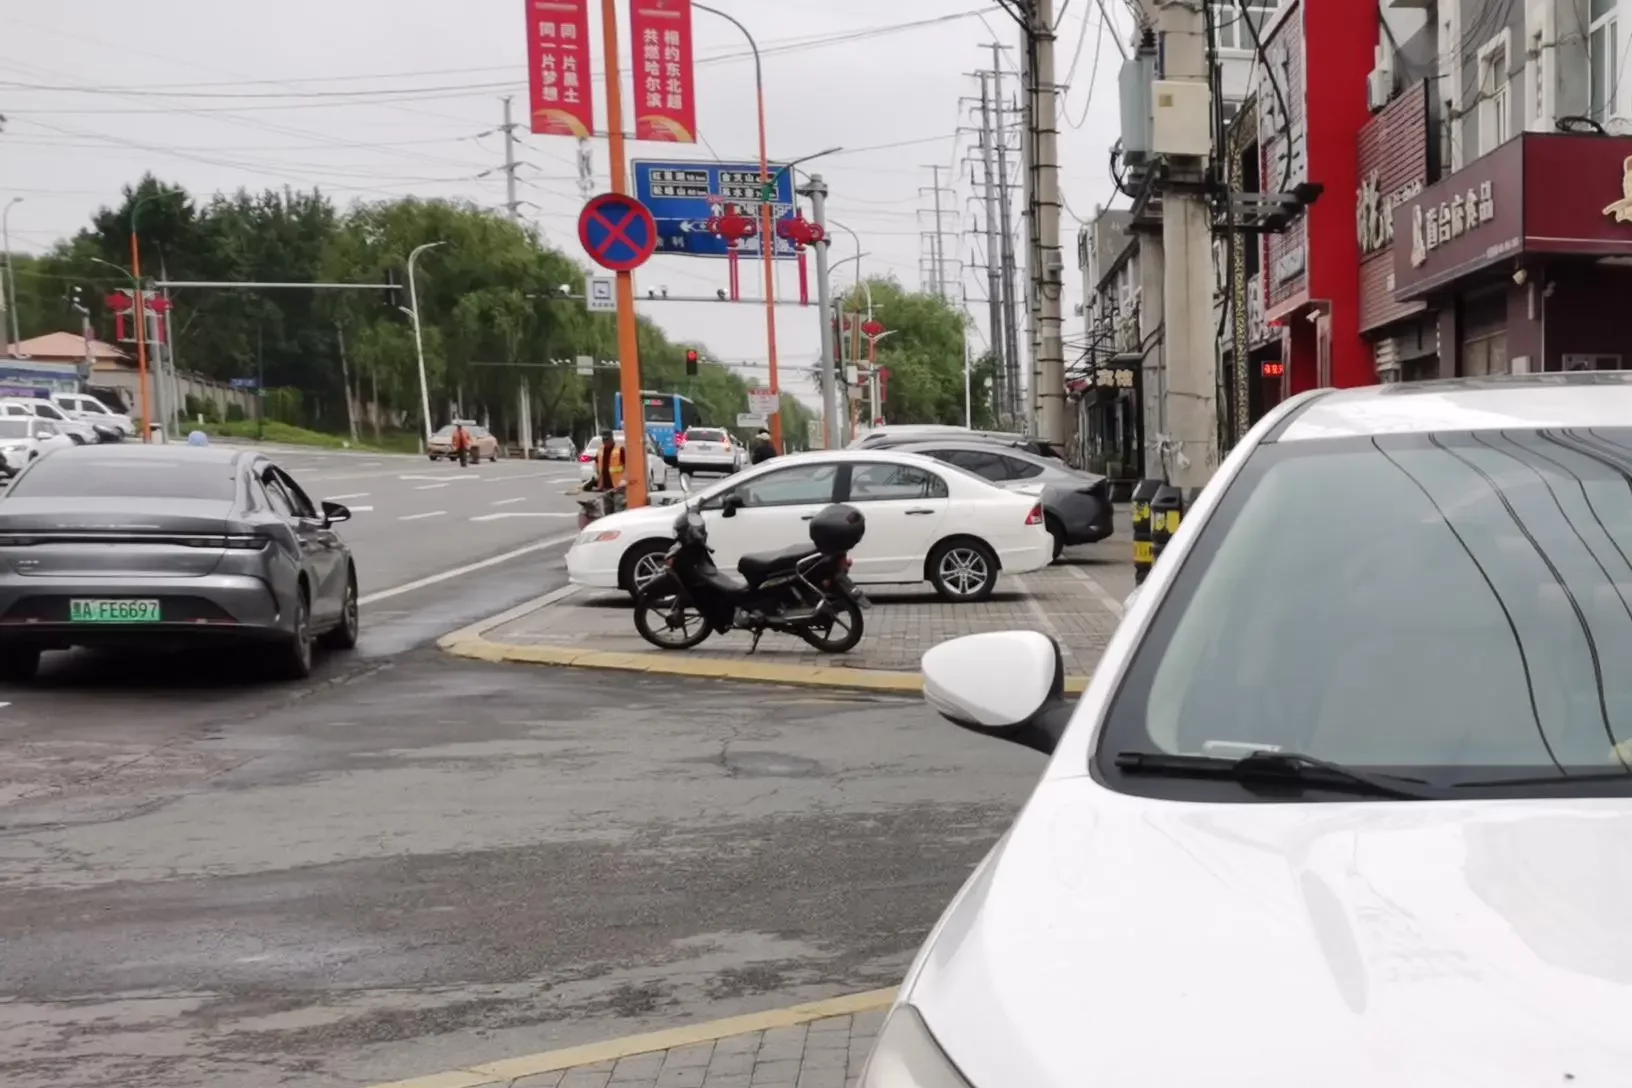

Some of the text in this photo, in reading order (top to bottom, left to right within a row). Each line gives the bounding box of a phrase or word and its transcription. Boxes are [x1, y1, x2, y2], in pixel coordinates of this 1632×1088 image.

[1425, 180, 1494, 251] 道台府食品
